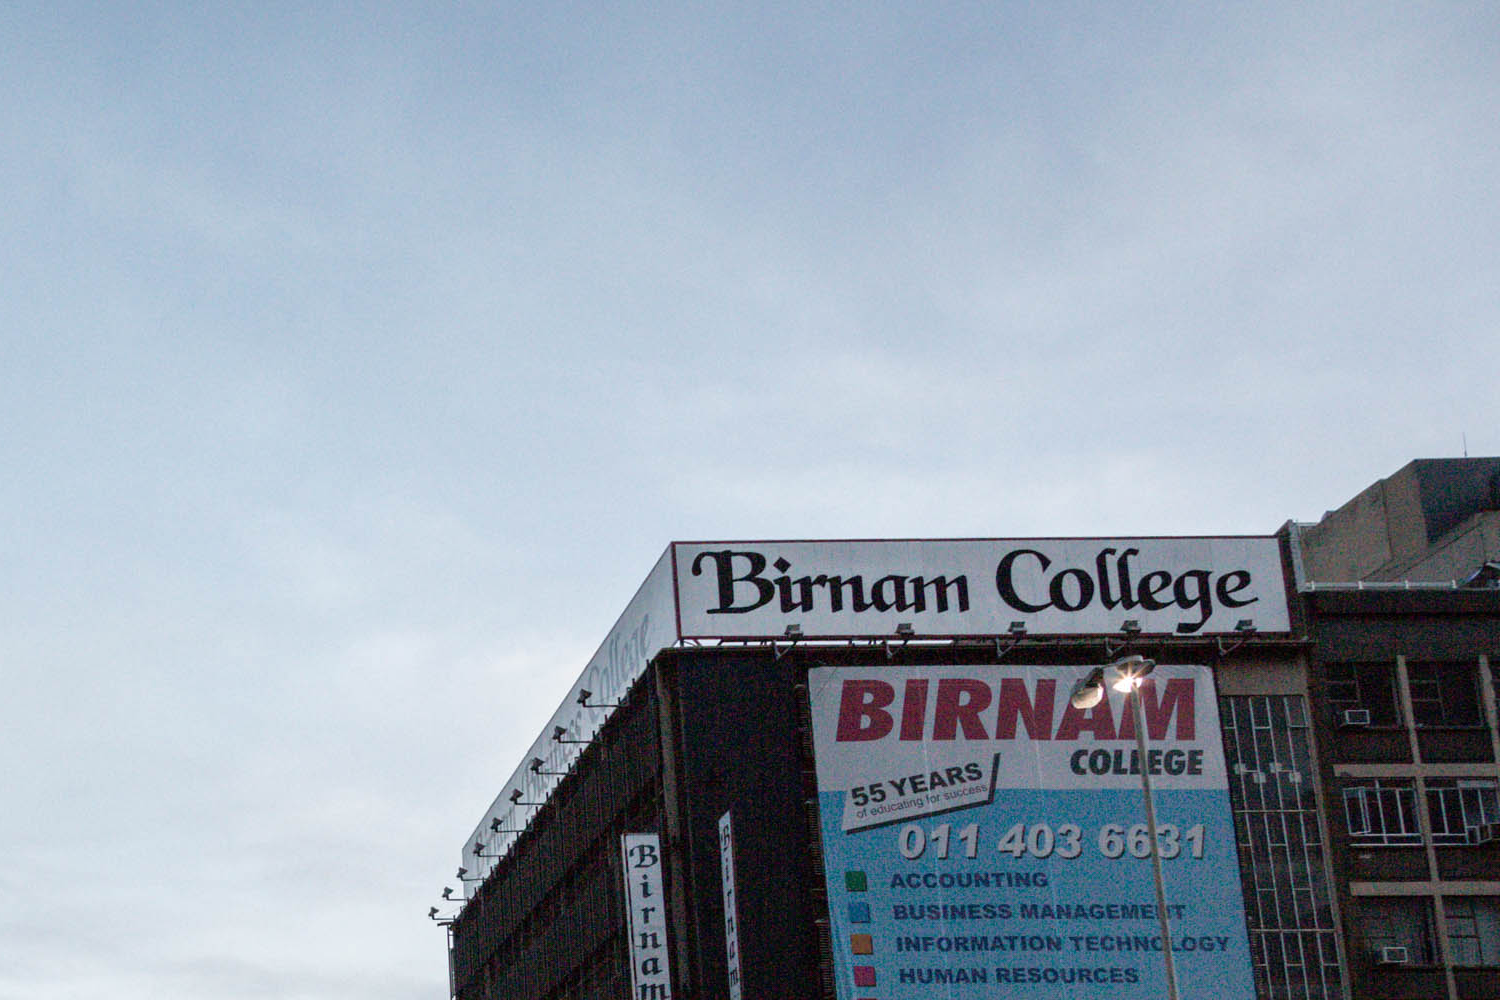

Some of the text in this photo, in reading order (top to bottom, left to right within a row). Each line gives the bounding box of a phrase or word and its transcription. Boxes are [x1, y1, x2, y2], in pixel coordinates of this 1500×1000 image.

[691, 547, 1259, 633] Birnam College
[835, 677, 1196, 742] BIRNAM
[1070, 749, 1203, 776] COLLEGE
[850, 762, 983, 808] 55 YEARS
[856, 783, 988, 819] of educating for success
[898, 823, 1206, 860] 011 403 6631
[890, 872, 1049, 889] ACCOUNTING
[894, 904, 1186, 921] BUSINESS MANAGEMENT
[896, 935, 1230, 953] INFORMATION TECHNOLOGY
[900, 967, 1140, 984] HUMAN RESOURCES
